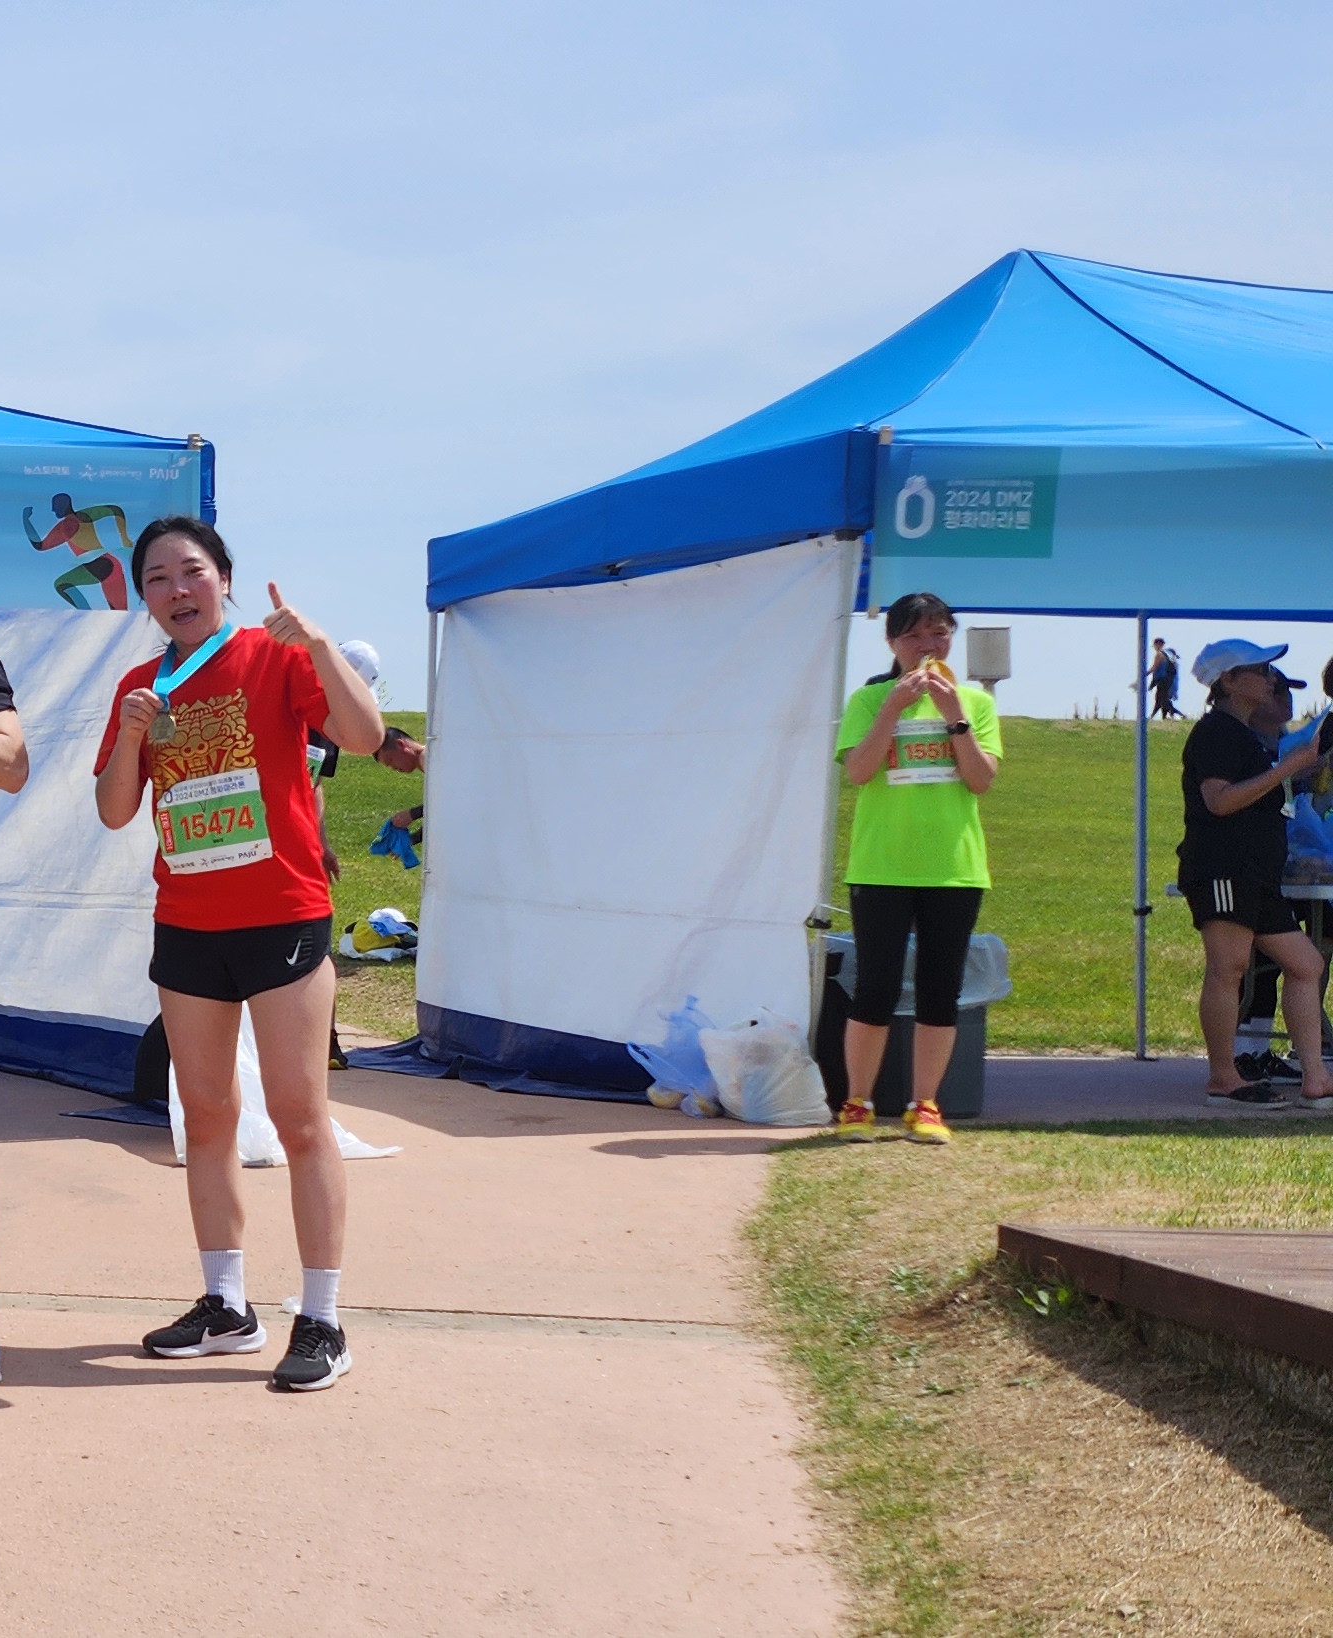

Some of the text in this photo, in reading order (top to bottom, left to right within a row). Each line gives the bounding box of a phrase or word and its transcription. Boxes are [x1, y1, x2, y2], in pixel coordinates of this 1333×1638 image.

[149, 468, 181, 480] PAJU
[944, 490, 1033, 508] 2024 DMZ
[180, 804, 256, 841] 15474
[238, 850, 257, 859] PAJU
